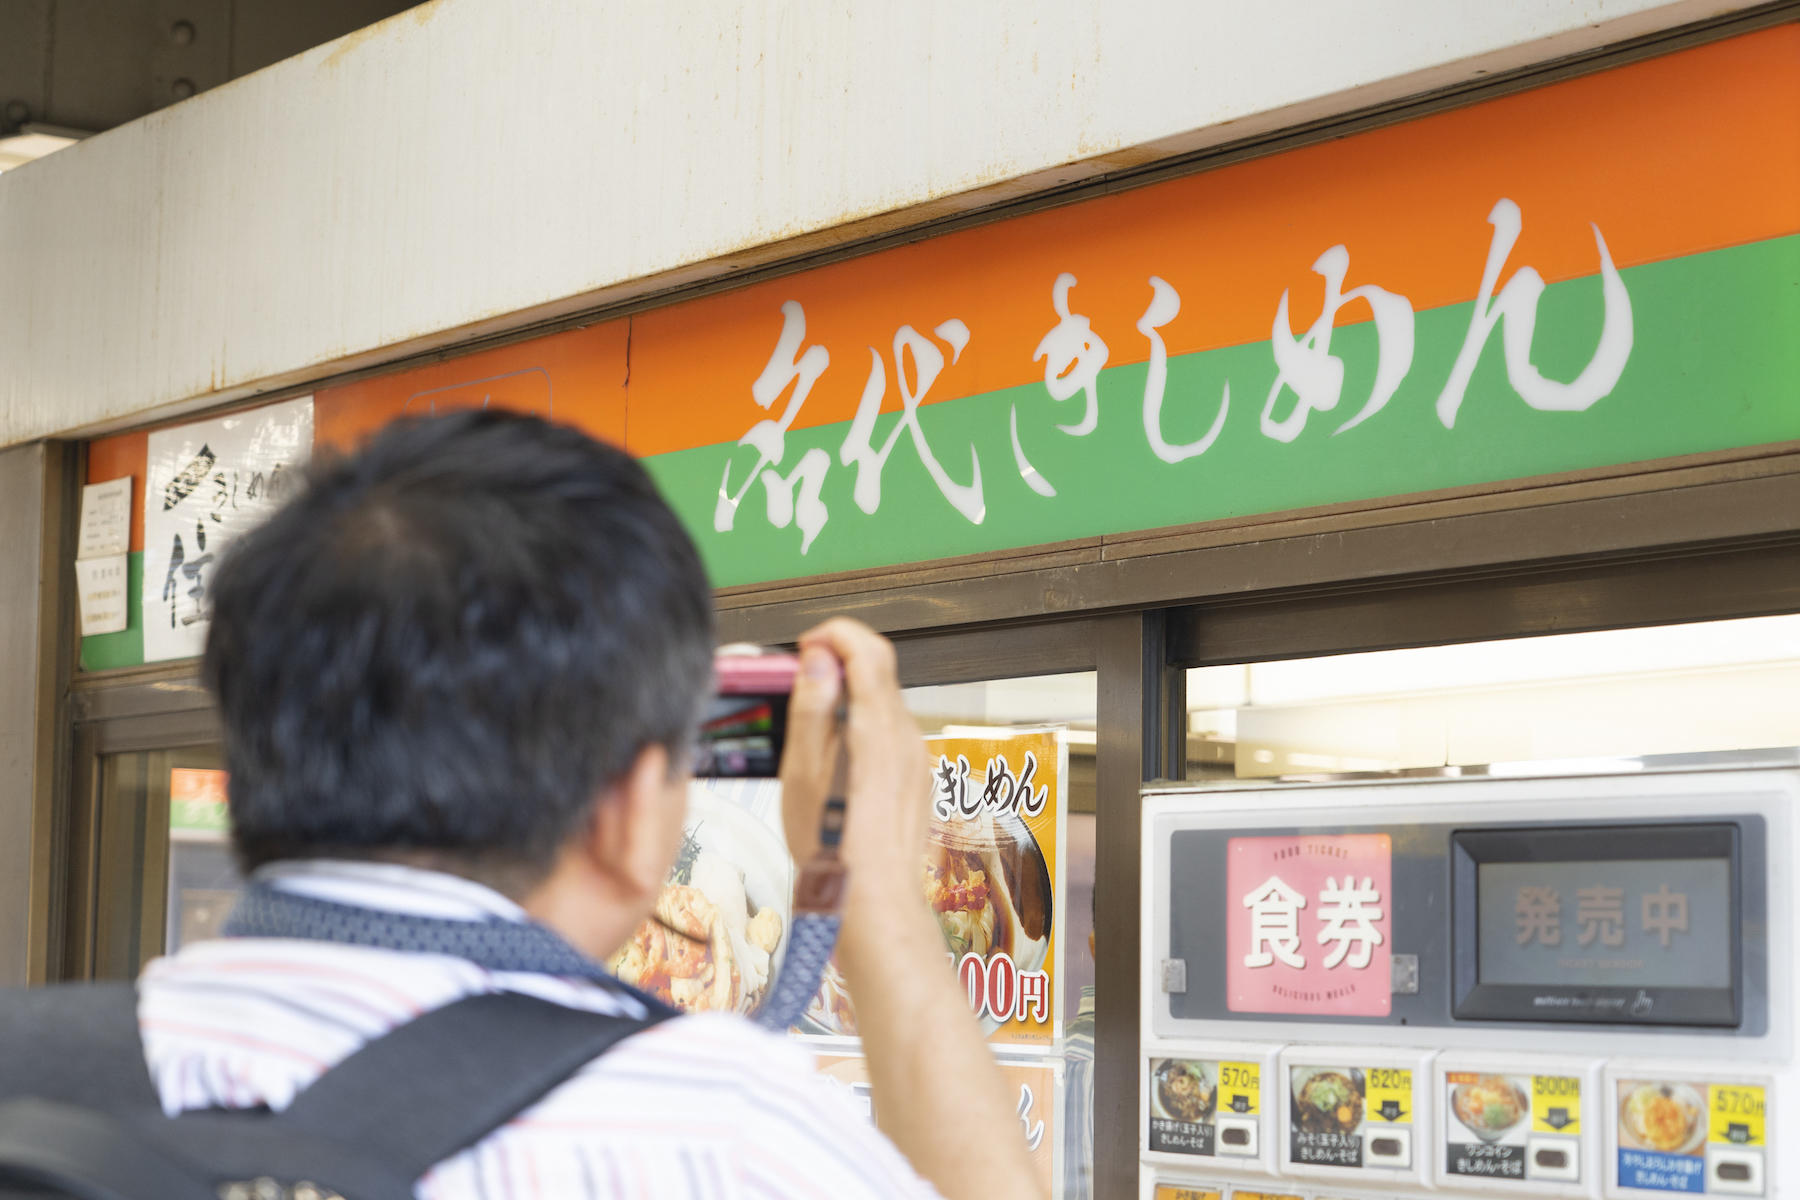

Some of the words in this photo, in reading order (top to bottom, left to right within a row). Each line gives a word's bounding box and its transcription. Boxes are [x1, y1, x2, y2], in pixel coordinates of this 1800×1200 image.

[714, 198, 1634, 555] 名代きしめん
[936, 755, 1046, 817] きしめん
[1243, 875, 1384, 969] 食券
[1515, 884, 1690, 949] 発売中
[946, 954, 1047, 1021] 00円
